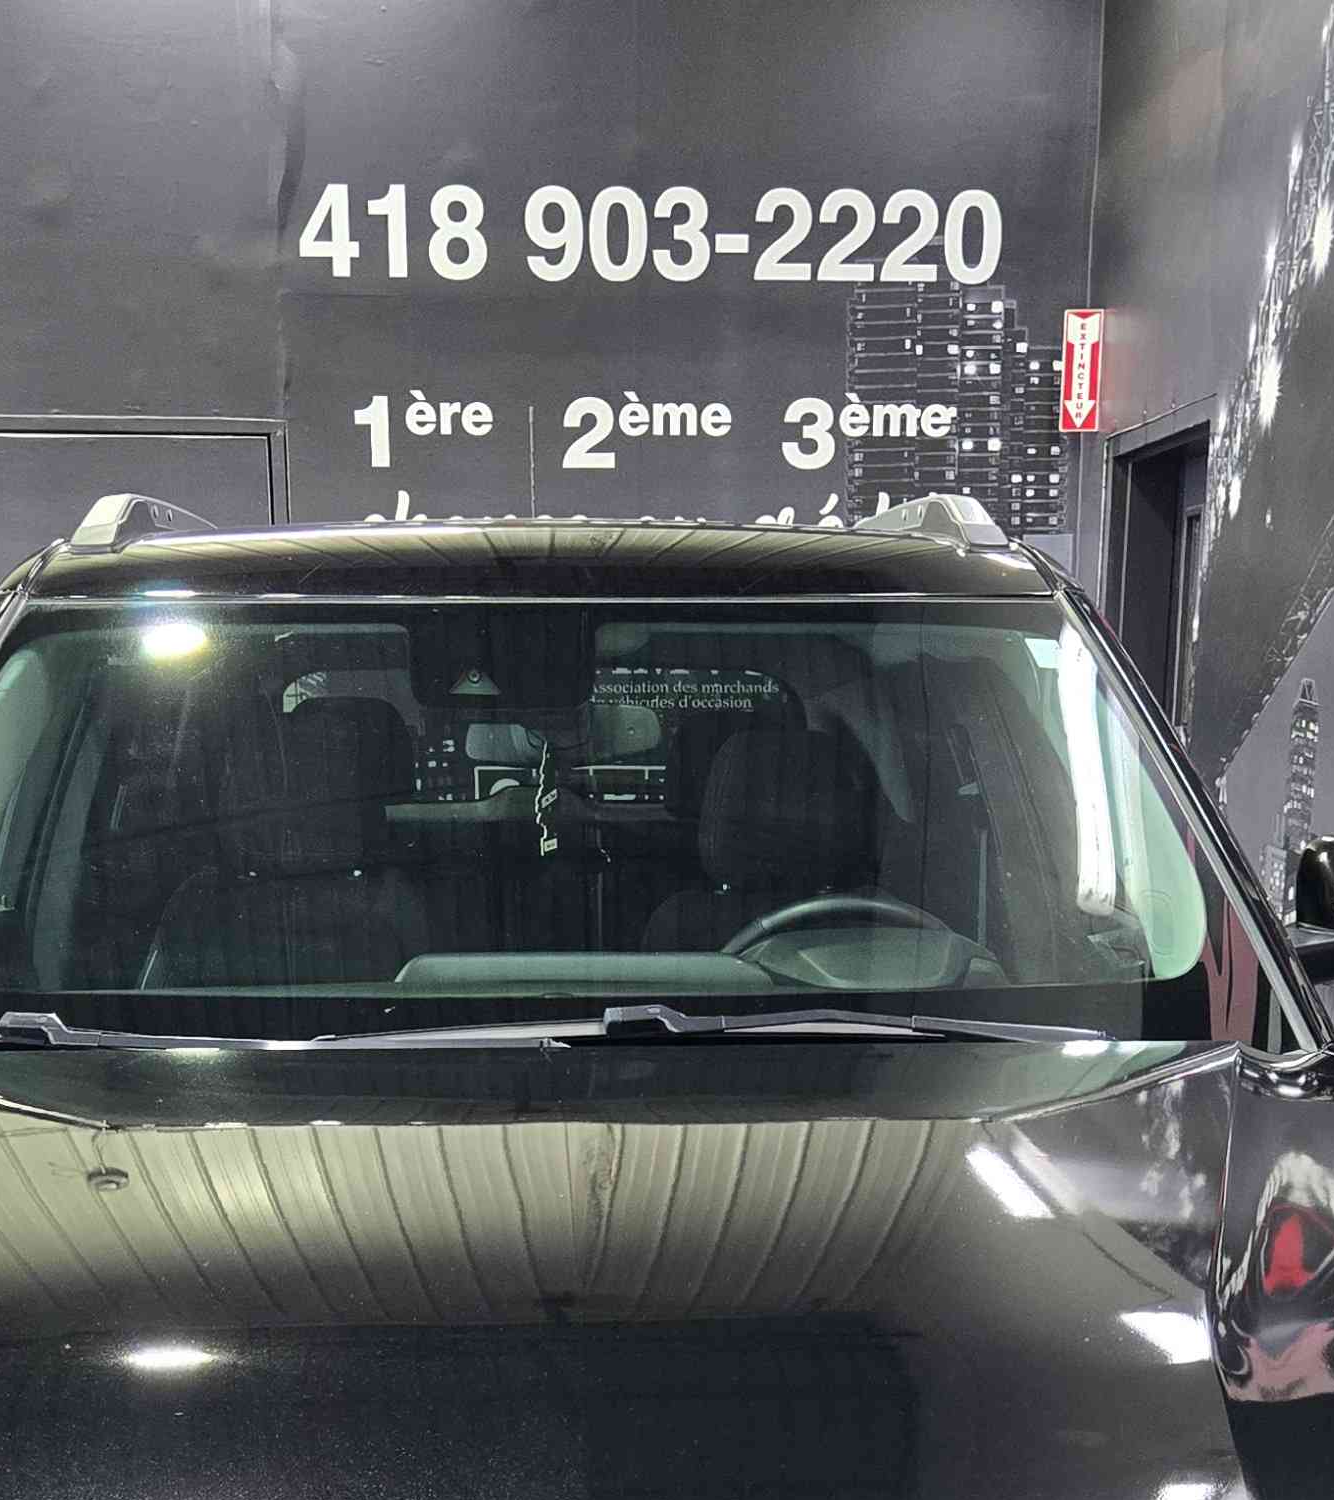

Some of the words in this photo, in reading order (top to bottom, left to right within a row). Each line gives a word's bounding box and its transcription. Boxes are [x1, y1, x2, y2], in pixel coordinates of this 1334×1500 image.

[298, 183, 487, 281] 418
[524, 184, 1003, 285] 903-2220
[1075, 322, 1087, 418] EXTINCTEUR
[353, 389, 494, 468] 1ère
[563, 391, 732, 470] 2ème
[782, 392, 957, 471] 3ème
[673, 679, 698, 694] des
[701, 677, 779, 693] marchands
[679, 695, 752, 708] d'occasion
